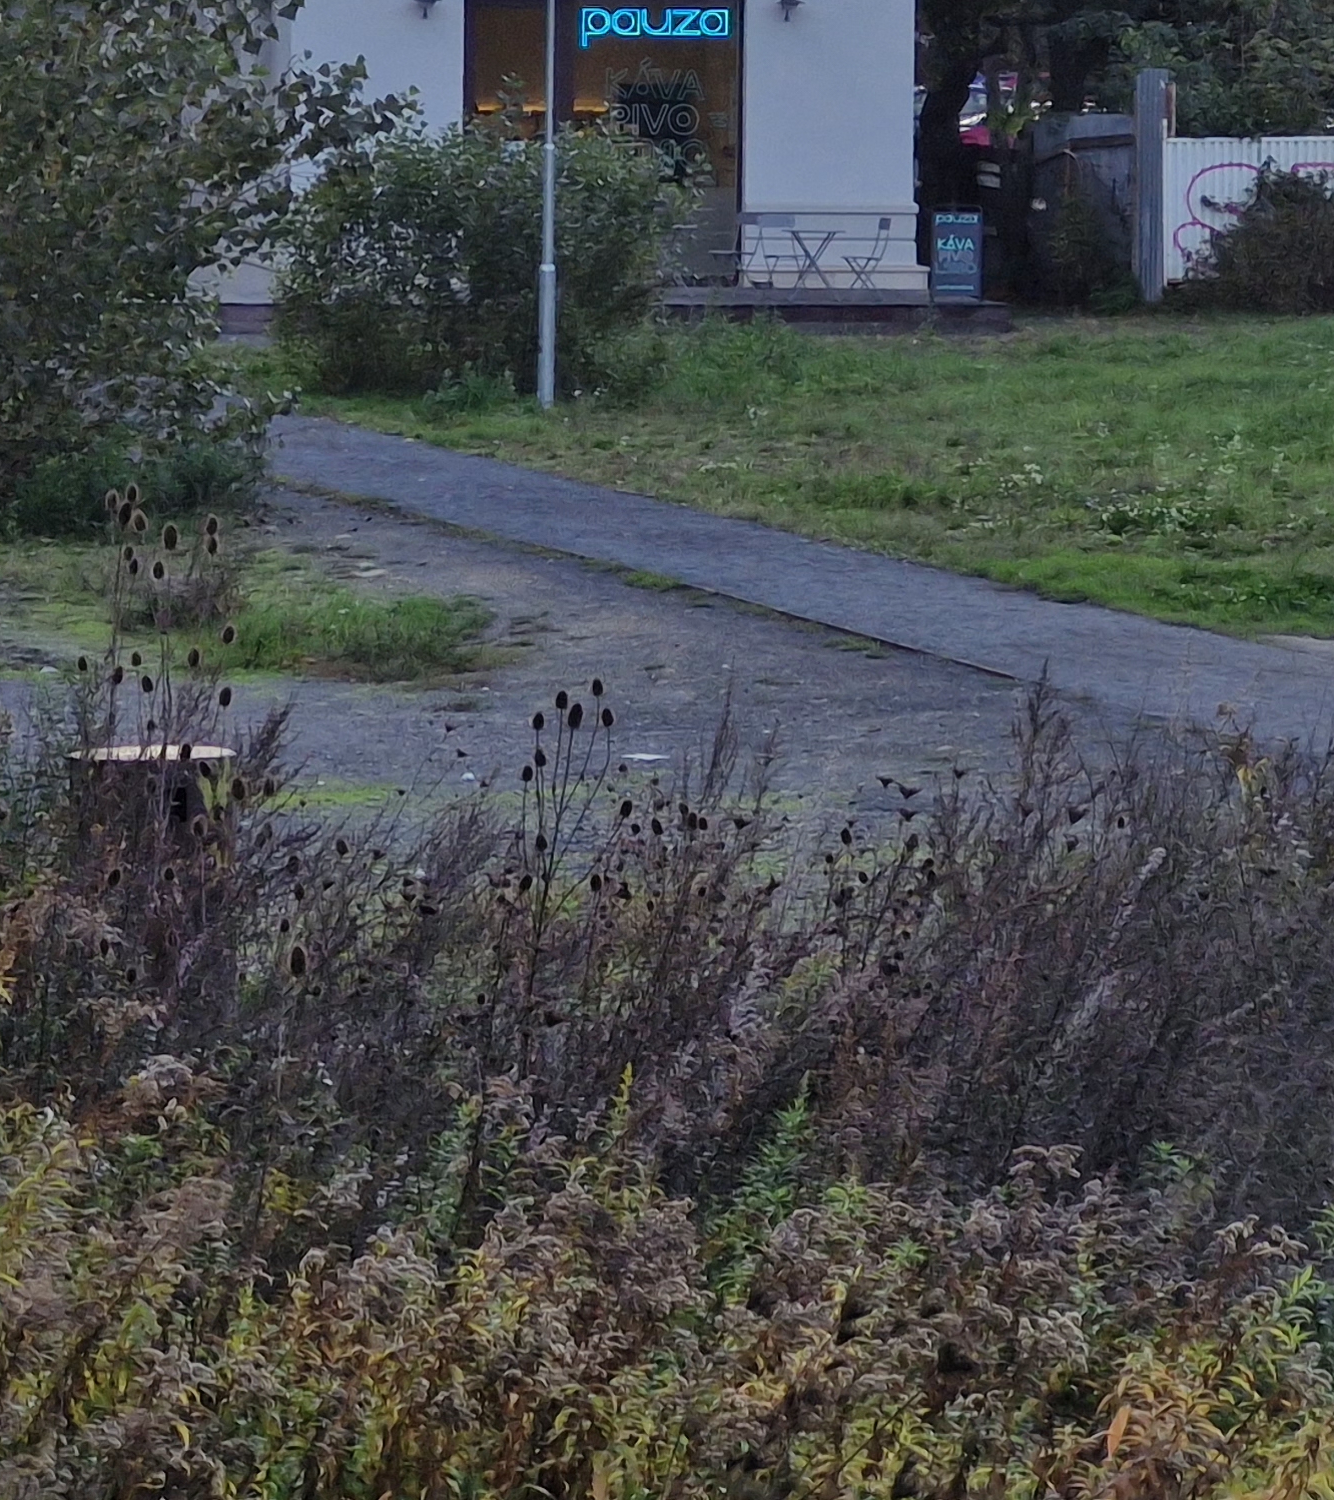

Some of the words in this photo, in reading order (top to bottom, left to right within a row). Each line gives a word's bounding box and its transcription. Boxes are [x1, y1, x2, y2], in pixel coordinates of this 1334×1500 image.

[580, 7, 730, 47] pauza
[604, 57, 705, 100] KÁVA
[609, 103, 700, 135] PIVO
[937, 234, 975, 250] KÁVA
